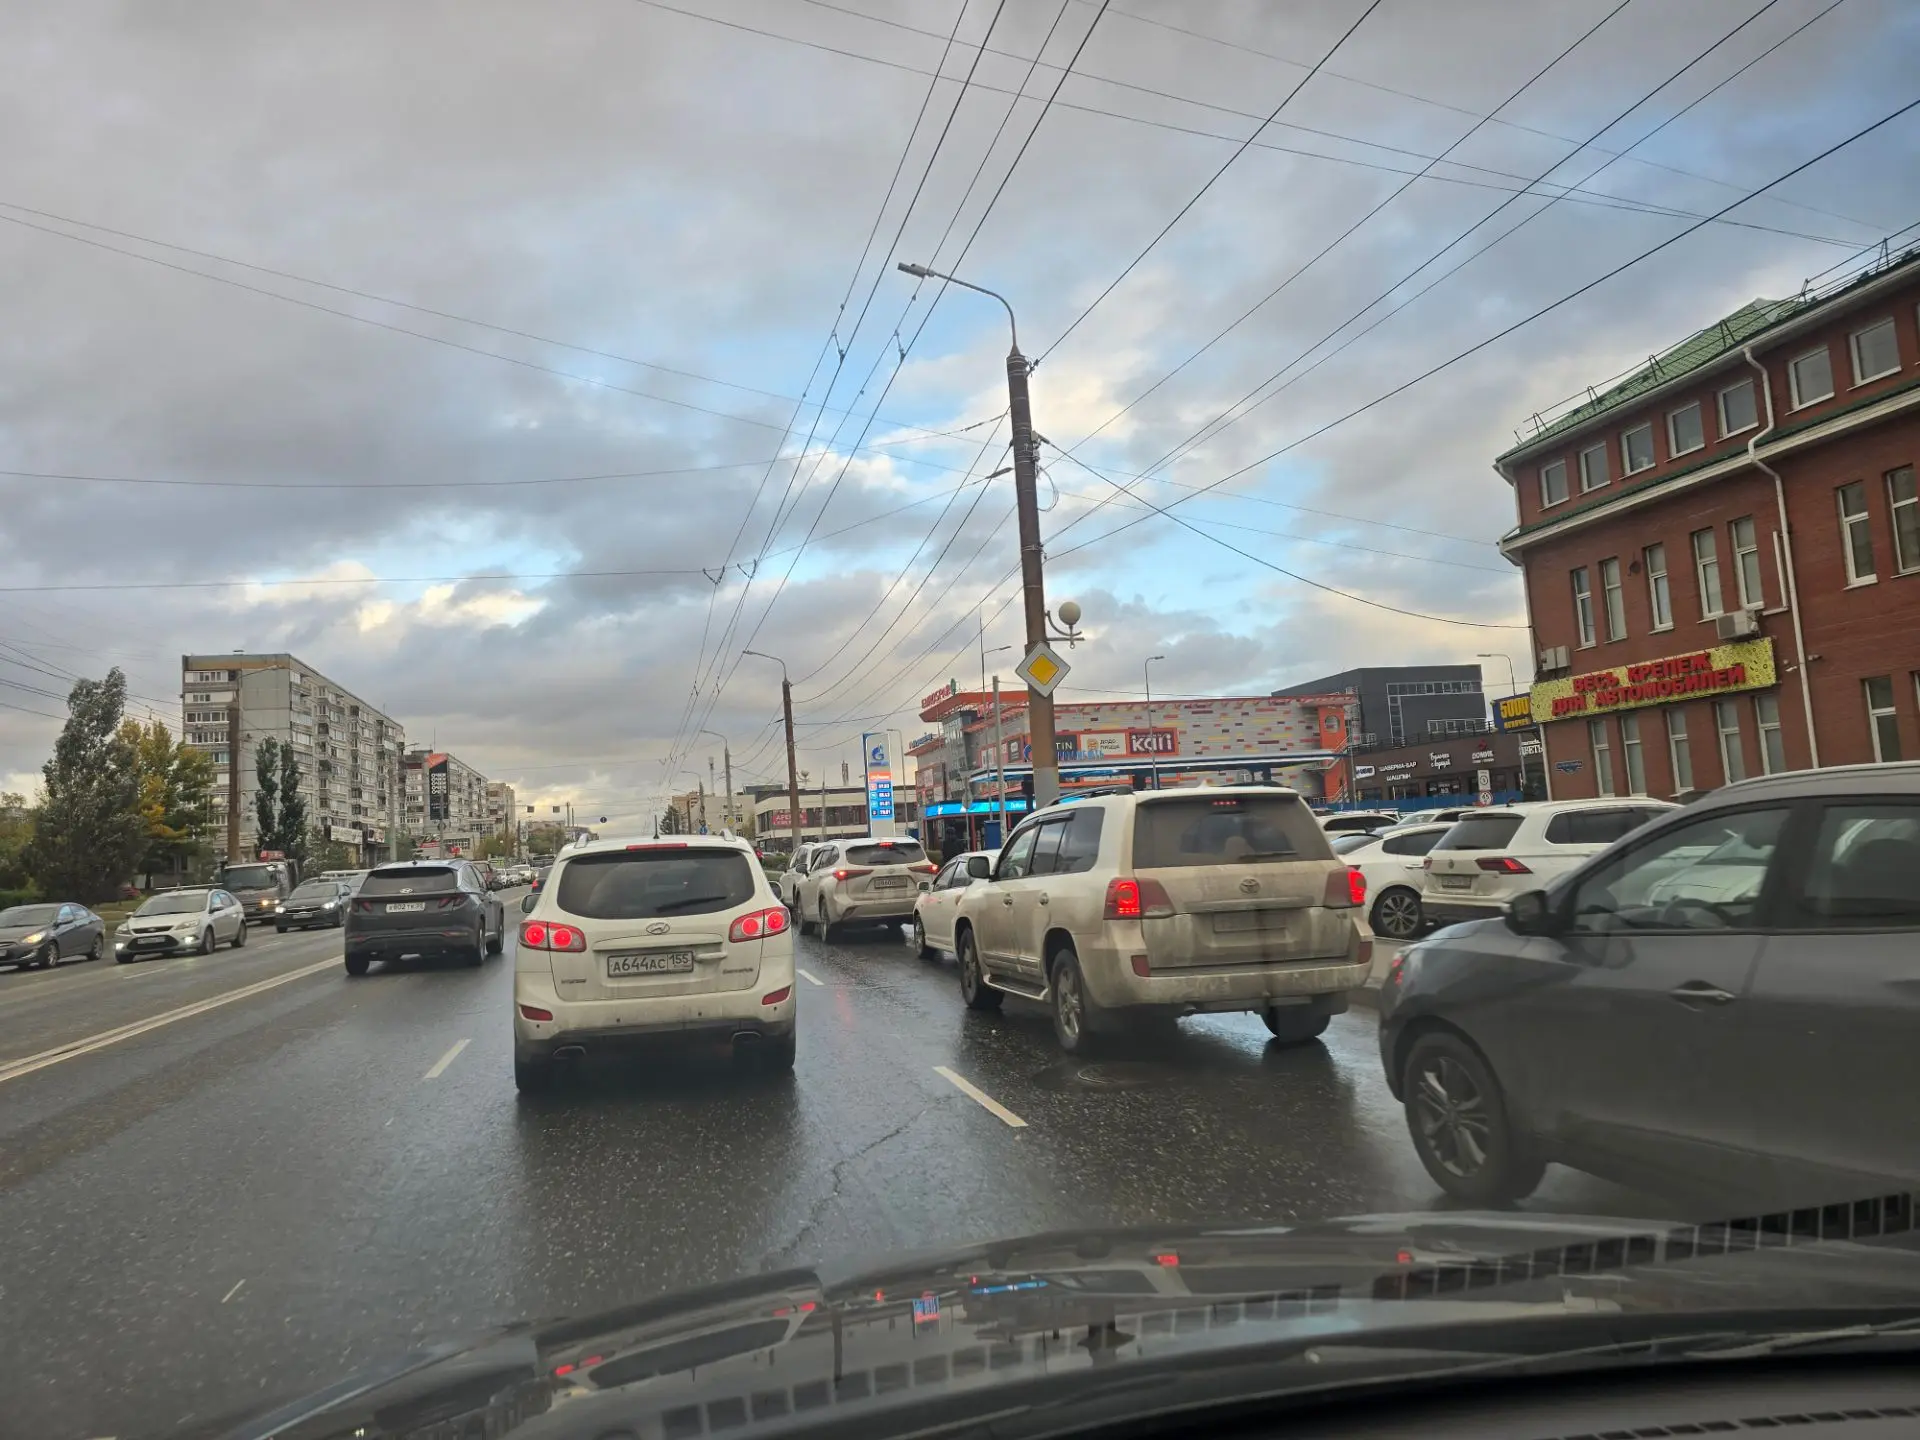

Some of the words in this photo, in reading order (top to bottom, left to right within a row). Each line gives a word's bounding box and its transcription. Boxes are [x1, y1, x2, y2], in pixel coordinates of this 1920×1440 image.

[1572, 672, 1620, 693] ВЕСЬ
[1626, 652, 1713, 684] КРЕПЕЖ
[1552, 694, 1587, 717] ДЛЯ
[1595, 664, 1746, 706] АВТОМОБИЛЕЙ
[1500, 697, 1530, 719] 5000
[1056, 741, 1073, 750] TIN
[1132, 734, 1172, 752] kari
[613, 956, 666, 974] А644АС
[669, 952, 691, 966] 155
